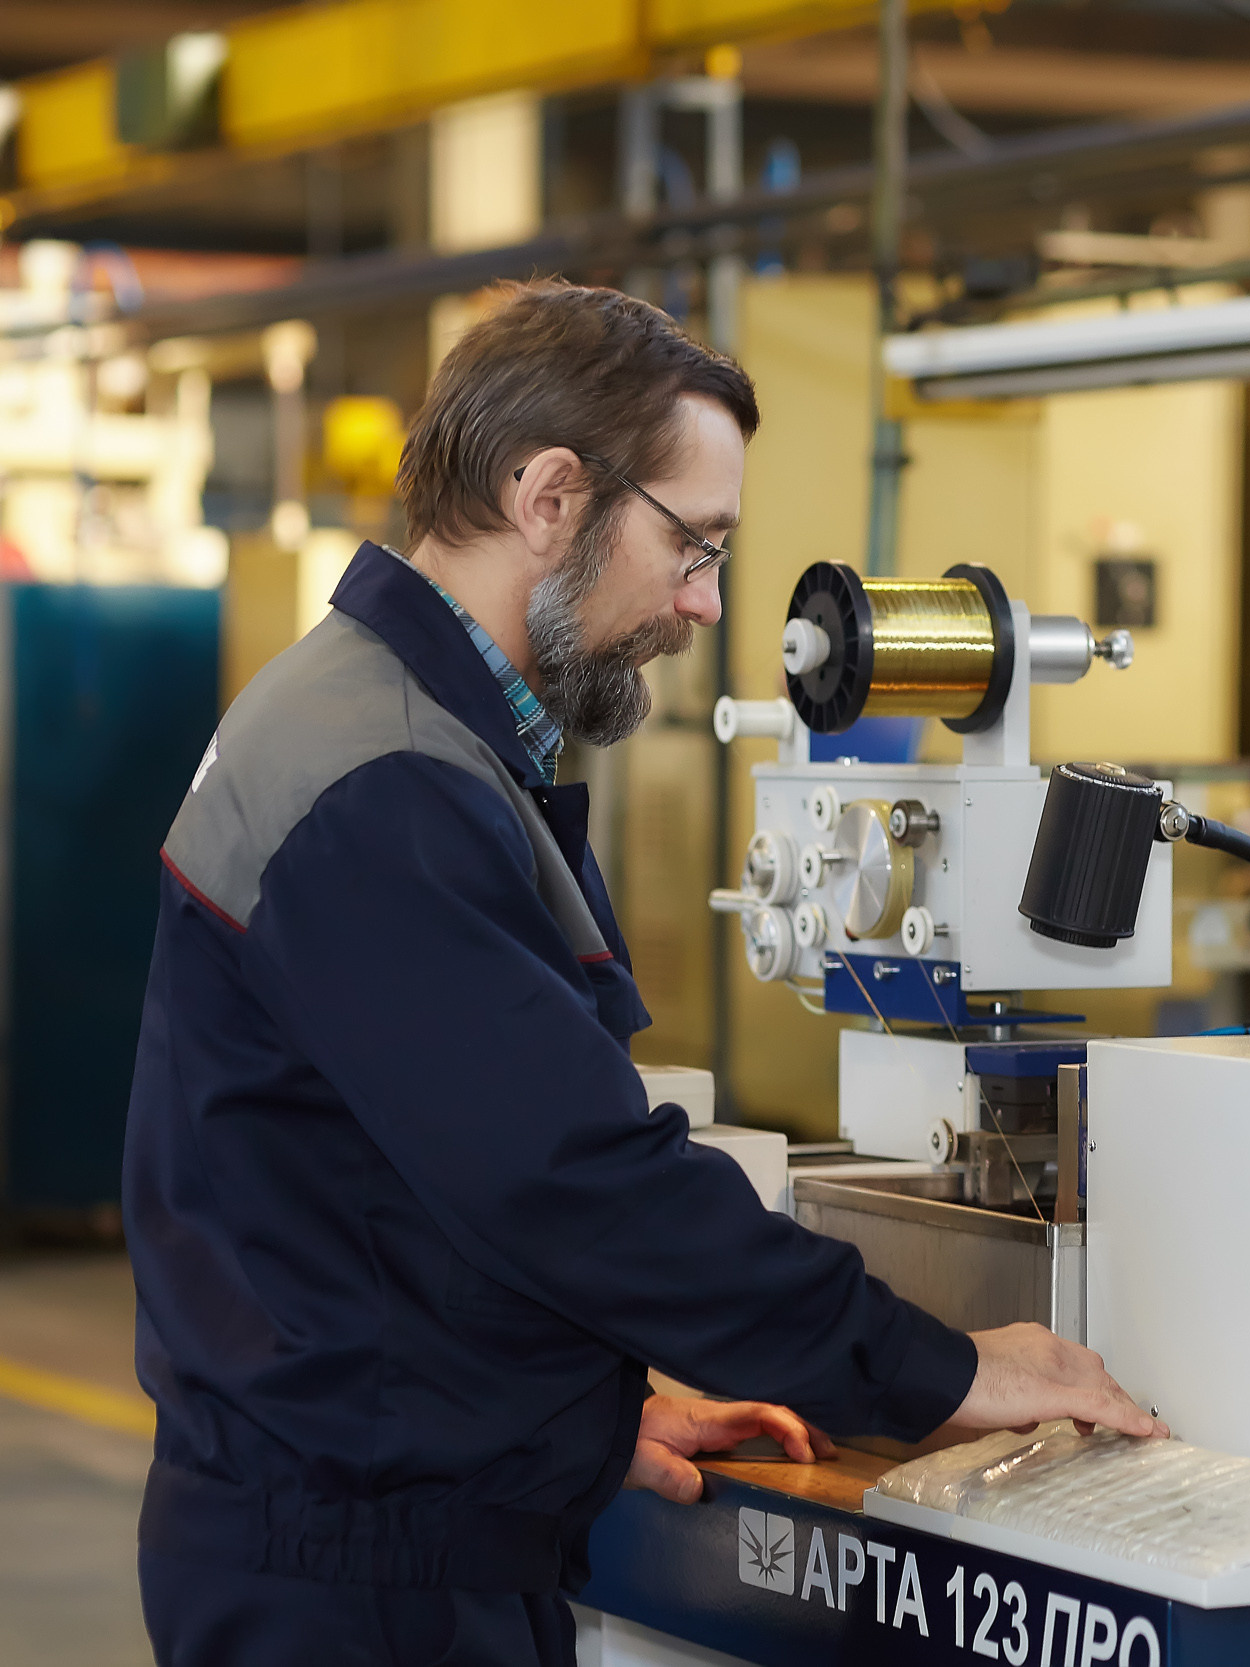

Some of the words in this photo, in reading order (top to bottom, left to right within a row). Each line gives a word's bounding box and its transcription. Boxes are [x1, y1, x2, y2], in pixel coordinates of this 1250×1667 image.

[801, 1527, 929, 1638] АРТА
[946, 1565, 1029, 1667] 123
[1040, 1592, 1161, 1667] ПРО
